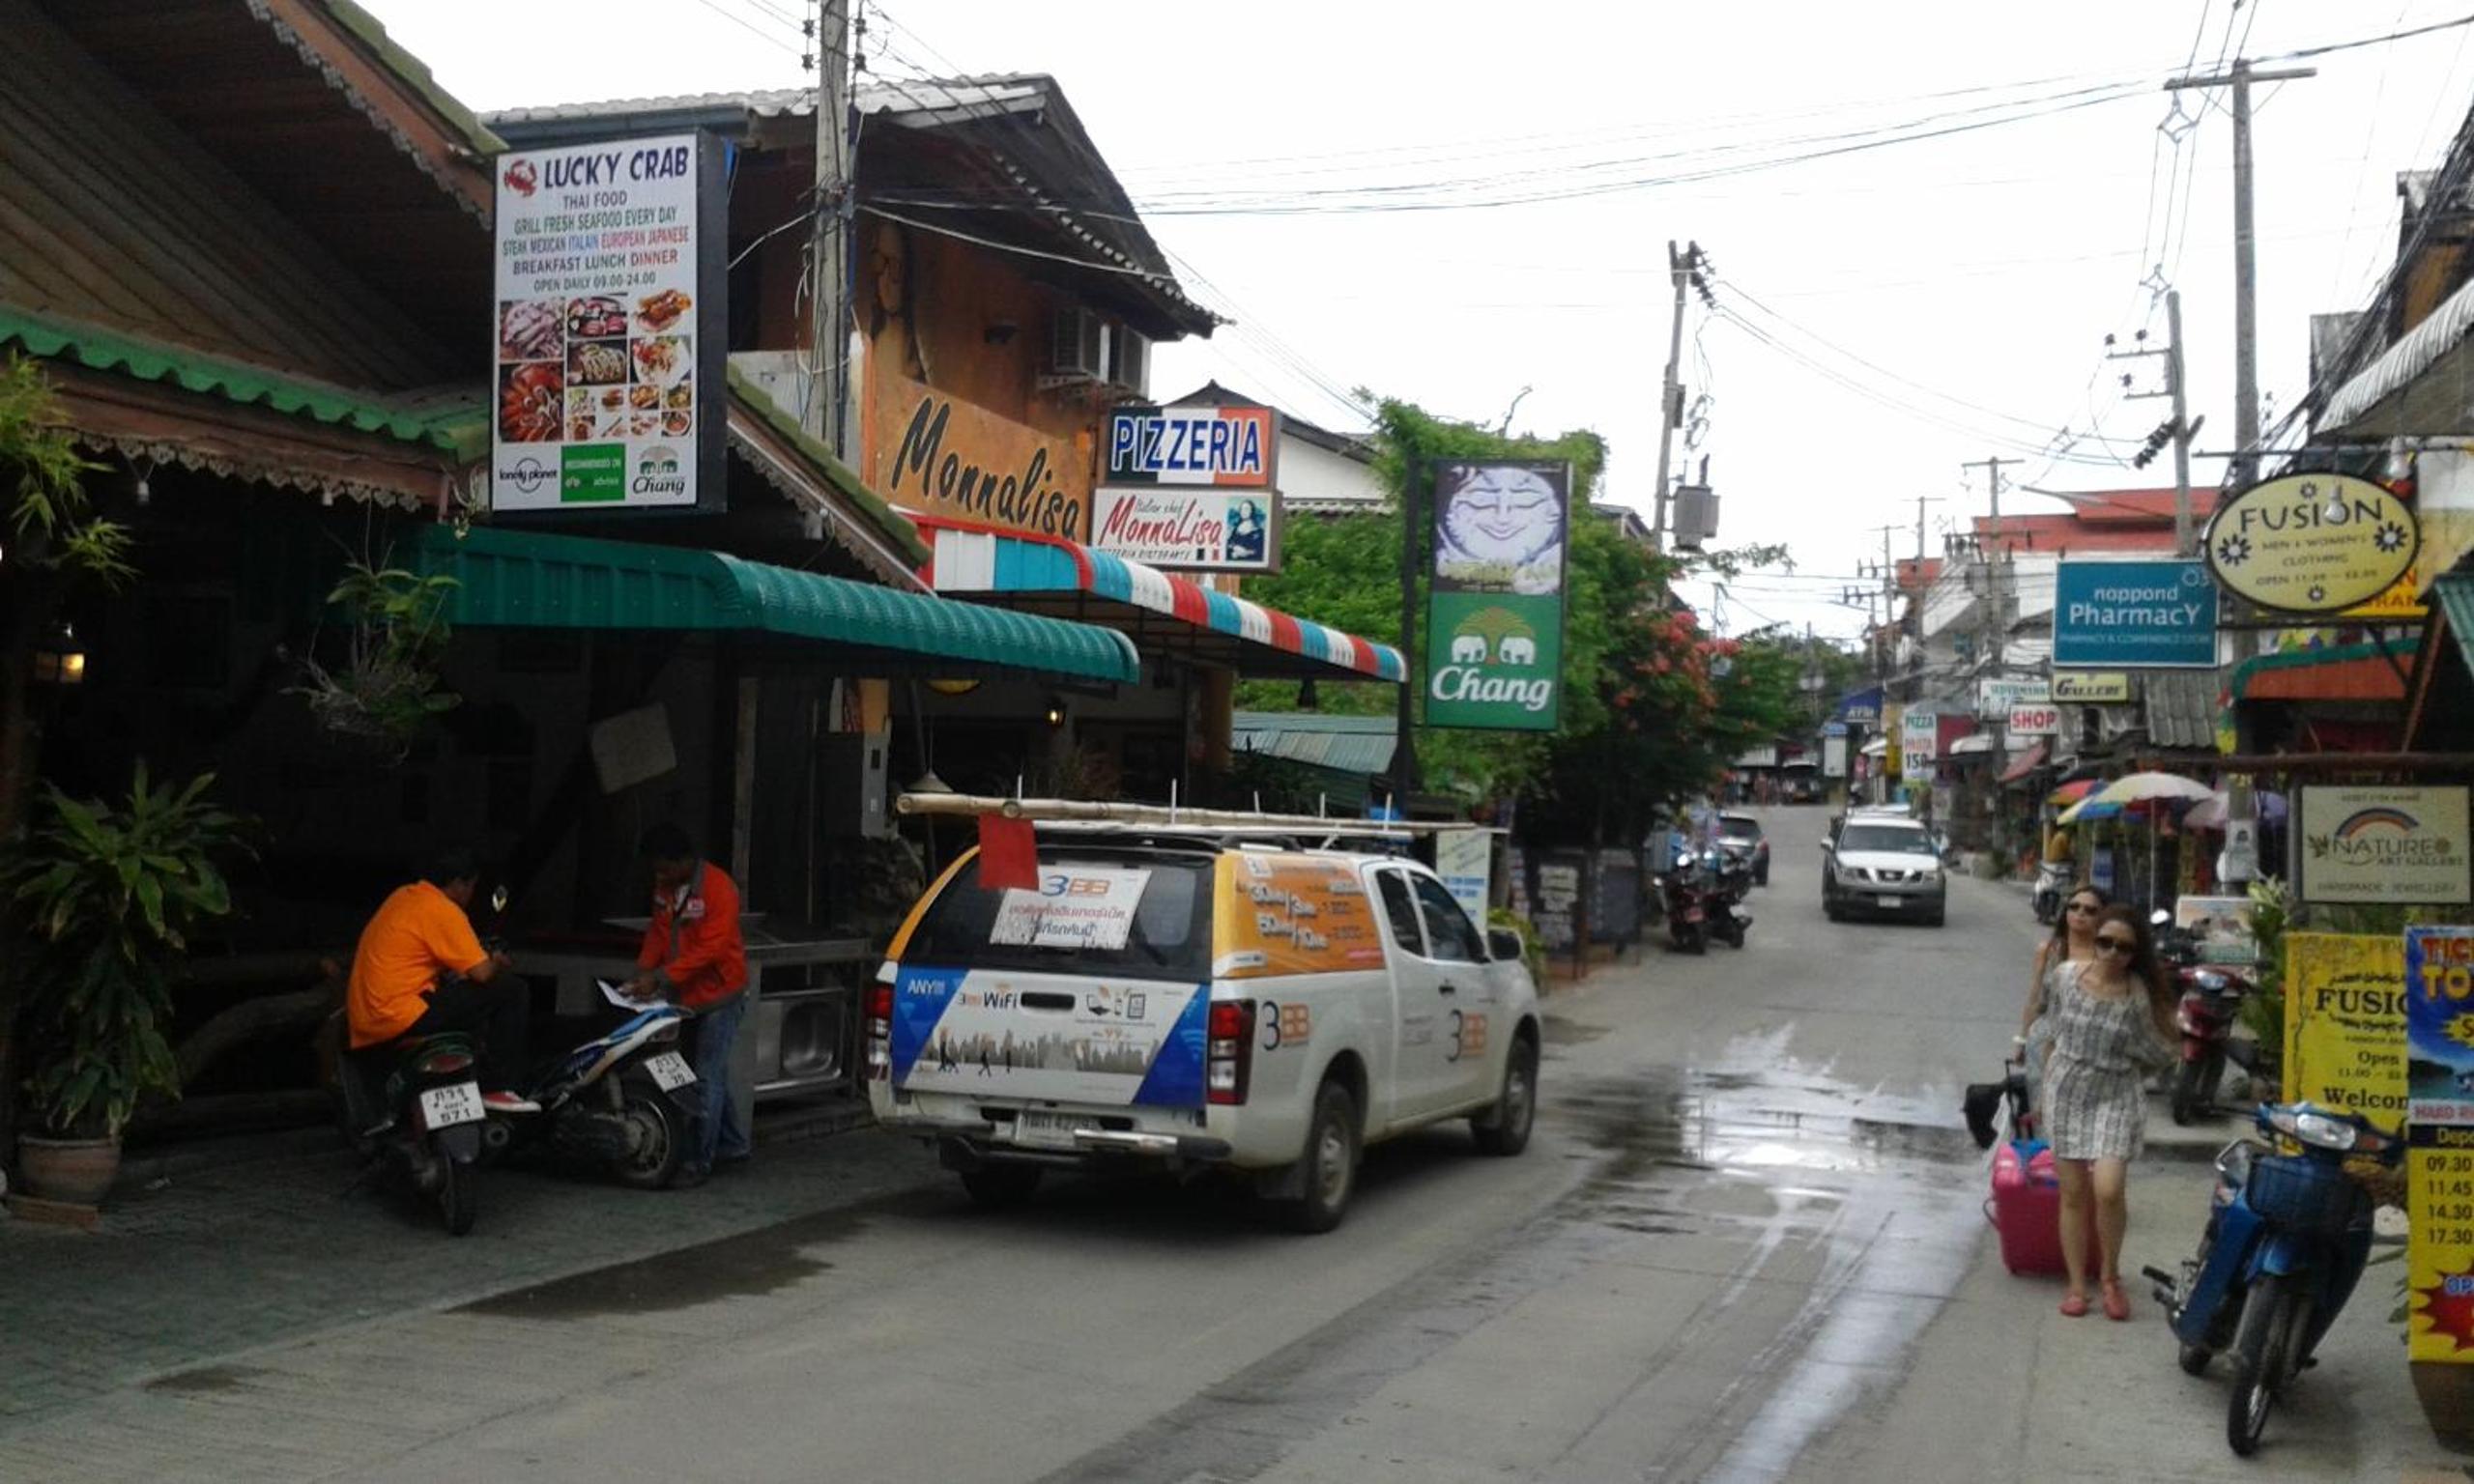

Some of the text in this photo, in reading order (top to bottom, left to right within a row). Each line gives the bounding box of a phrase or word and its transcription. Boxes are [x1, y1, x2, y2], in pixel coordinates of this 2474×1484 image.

[544, 146, 689, 188] LUCKY CRAB
[563, 190, 627, 210] THAI FOOD
[514, 206, 676, 236] GRILL FRESH SEAFOOD EVERY DAY
[601, 230, 646, 249] EUROPEAN
[647, 226, 689, 245] JAPANESE
[513, 250, 678, 275] BREAKFAST LUNCH DINNER
[533, 275, 561, 292] OPEN
[563, 273, 590, 290] DAILY
[1111, 415, 1264, 473] PIZZERIA
[500, 468, 558, 482] lonely planet
[891, 396, 1080, 541] Monnalisa
[632, 475, 685, 496] Chang
[2093, 584, 2179, 605] noppond
[1431, 665, 1552, 711] Chang
[1905, 716, 1934, 728] PIZZA
[2012, 709, 2057, 729] SHOP
[2334, 838, 2434, 856] NATURE
[2421, 936, 2474, 959] TIC
[2357, 1050, 2400, 1067] Open
[2427, 1155, 2472, 1172] 09.30
[2428, 1179, 2472, 1197] 11.45
[2428, 1204, 2473, 1221] 14.30
[2428, 1227, 2473, 1245] 17.30
[2444, 1274, 2474, 1298] OP
